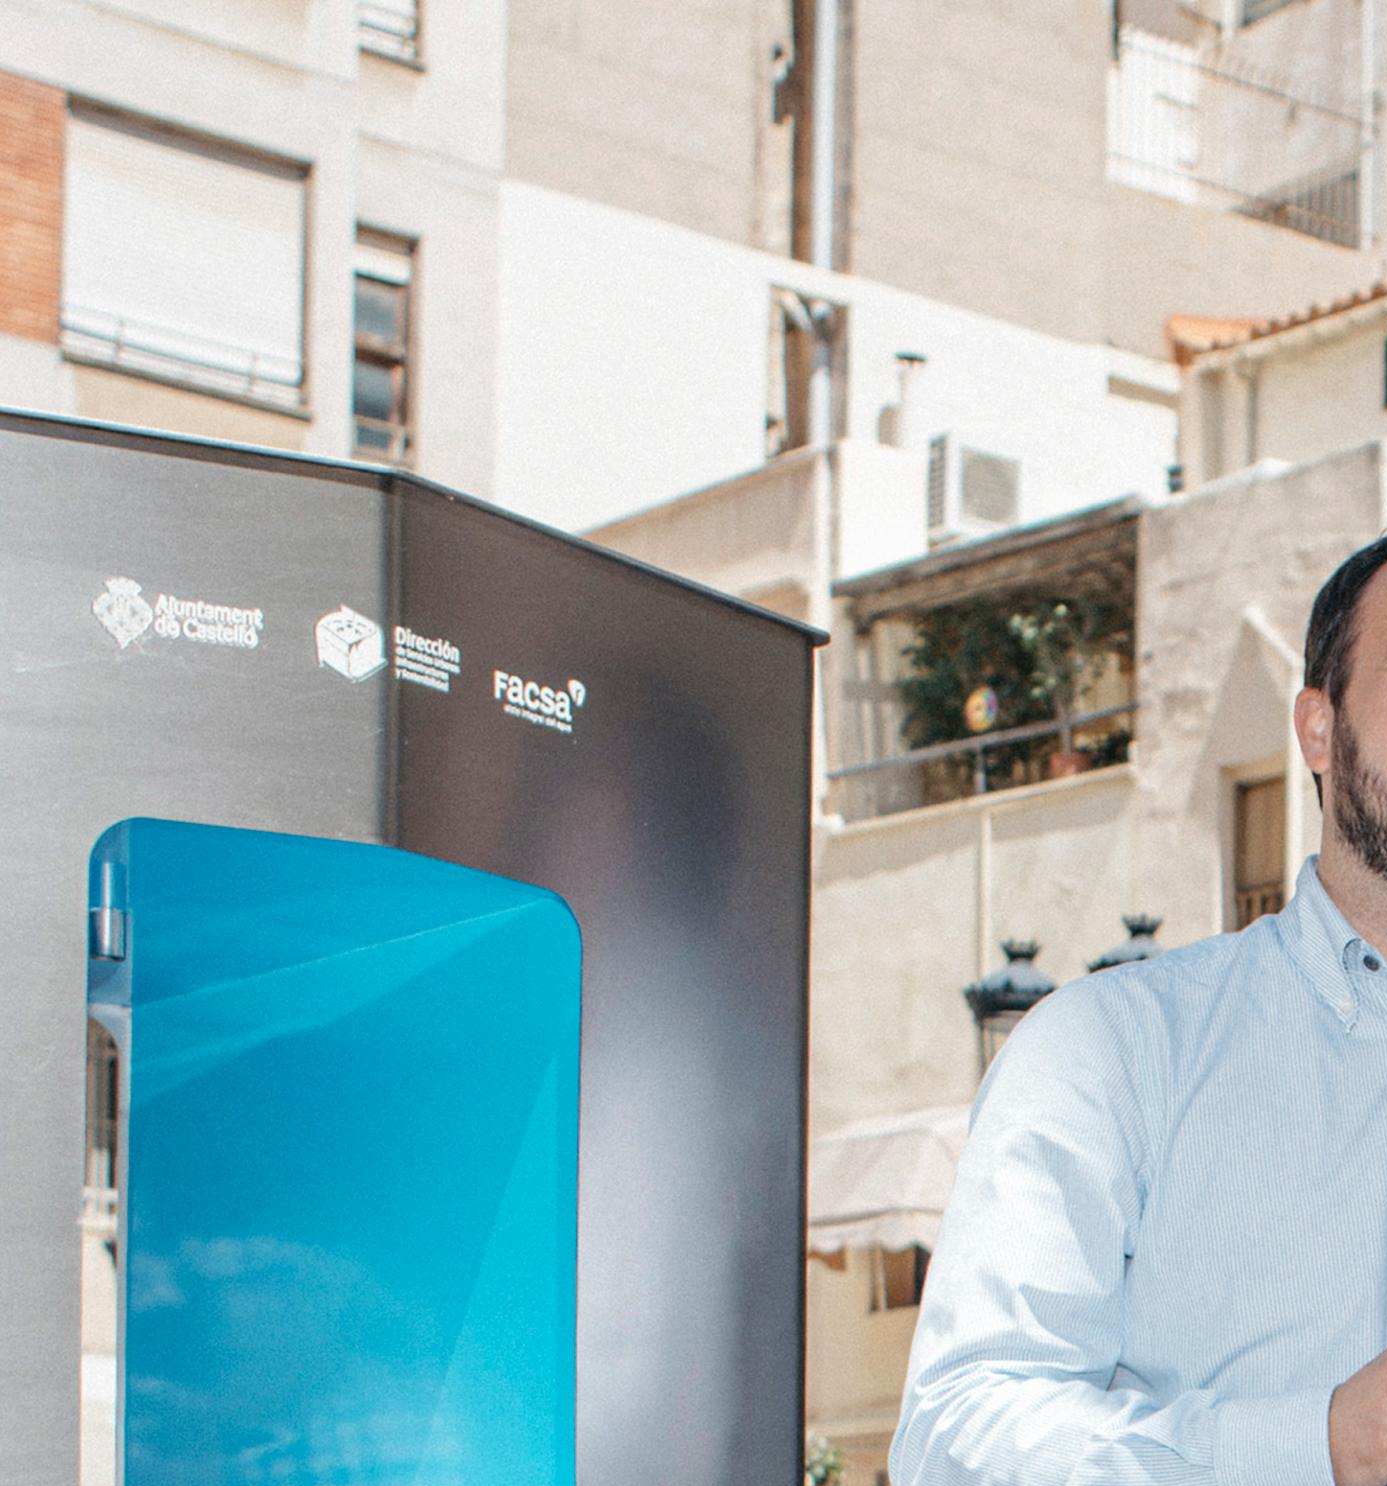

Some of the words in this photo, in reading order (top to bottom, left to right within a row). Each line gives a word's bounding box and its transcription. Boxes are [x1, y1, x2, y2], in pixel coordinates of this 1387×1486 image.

[155, 593, 263, 627] Ajuntament
[183, 618, 258, 648] Castelló
[394, 625, 461, 664] Dirección
[494, 670, 573, 722] Facsa
